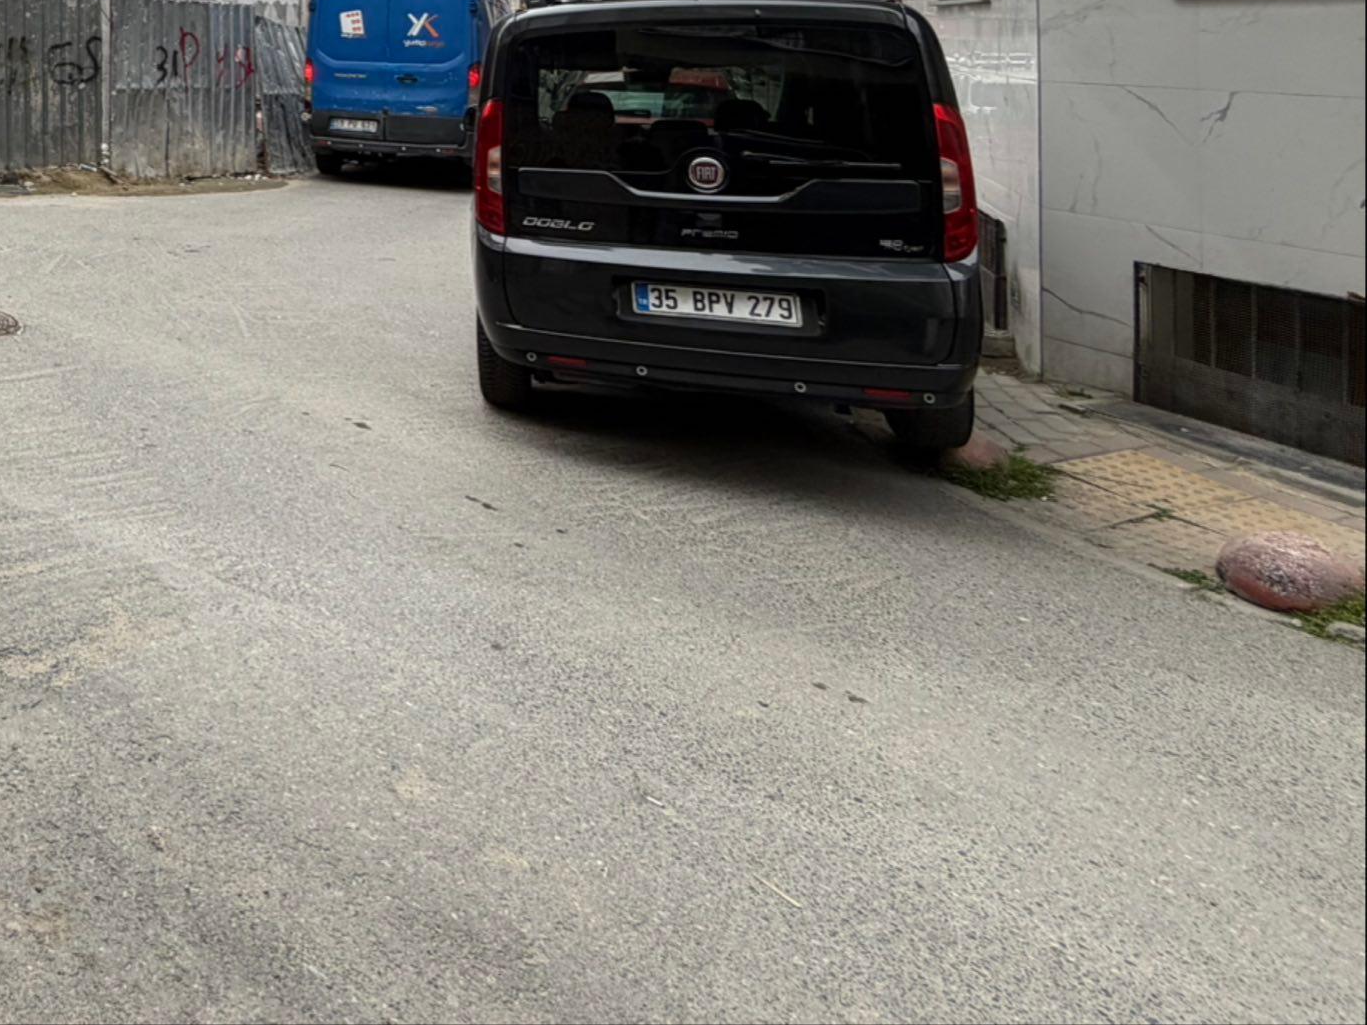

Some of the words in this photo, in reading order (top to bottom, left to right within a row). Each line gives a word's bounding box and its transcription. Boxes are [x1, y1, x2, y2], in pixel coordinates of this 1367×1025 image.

[696, 166, 716, 181] FIAT
[650, 288, 678, 310] 35
[691, 290, 735, 315] BPV
[747, 295, 793, 320] 279
